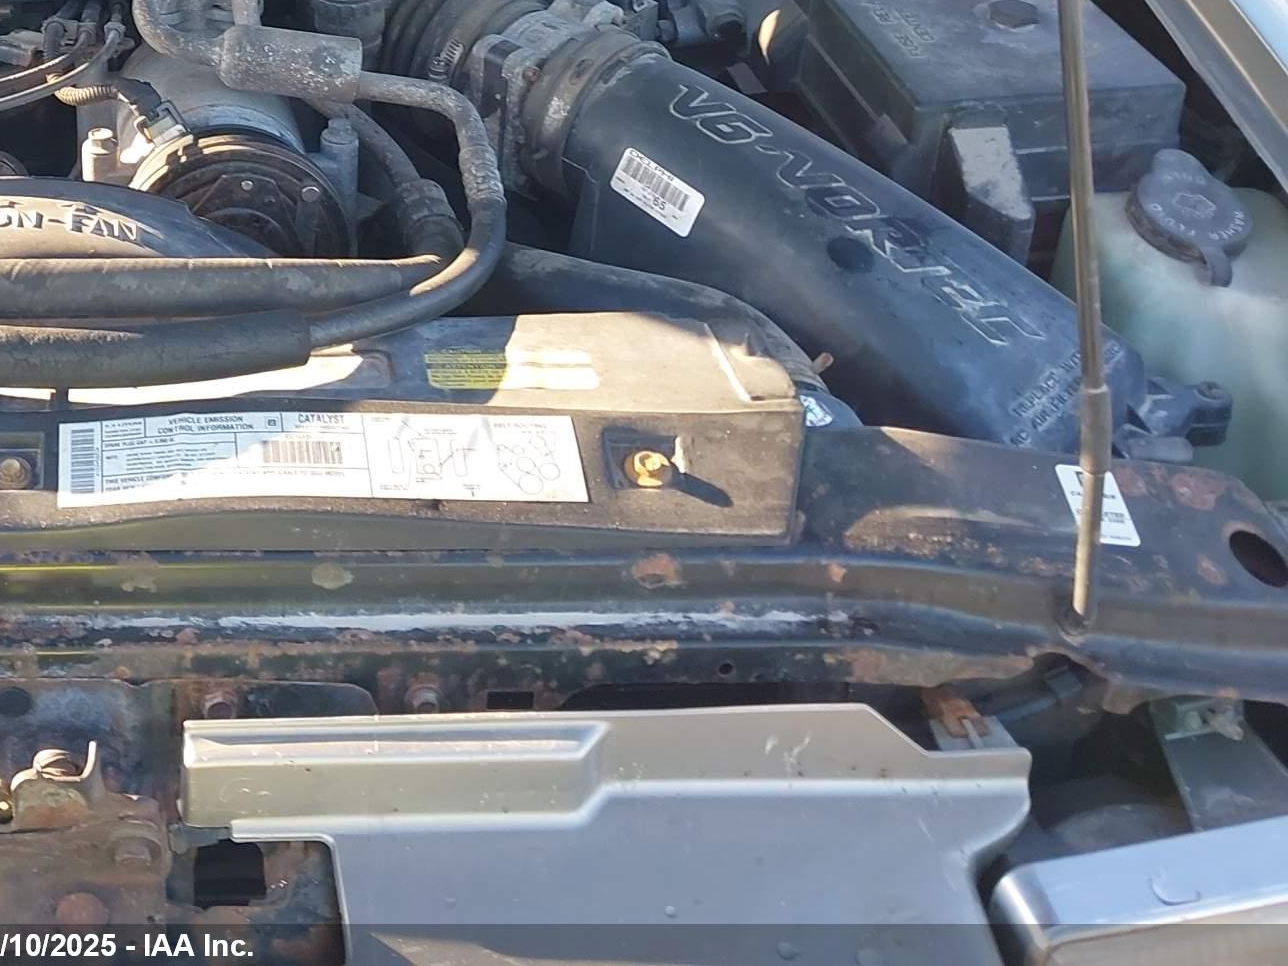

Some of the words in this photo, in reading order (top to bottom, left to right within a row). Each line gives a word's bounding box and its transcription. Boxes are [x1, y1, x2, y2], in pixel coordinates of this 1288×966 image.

[168, 416, 201, 426] VEHICLE
[204, 414, 245, 424] EMISSION
[297, 412, 345, 425] CATALYST
[157, 423, 195, 434] CONTROL
[197, 422, 255, 432] INFORMATION
